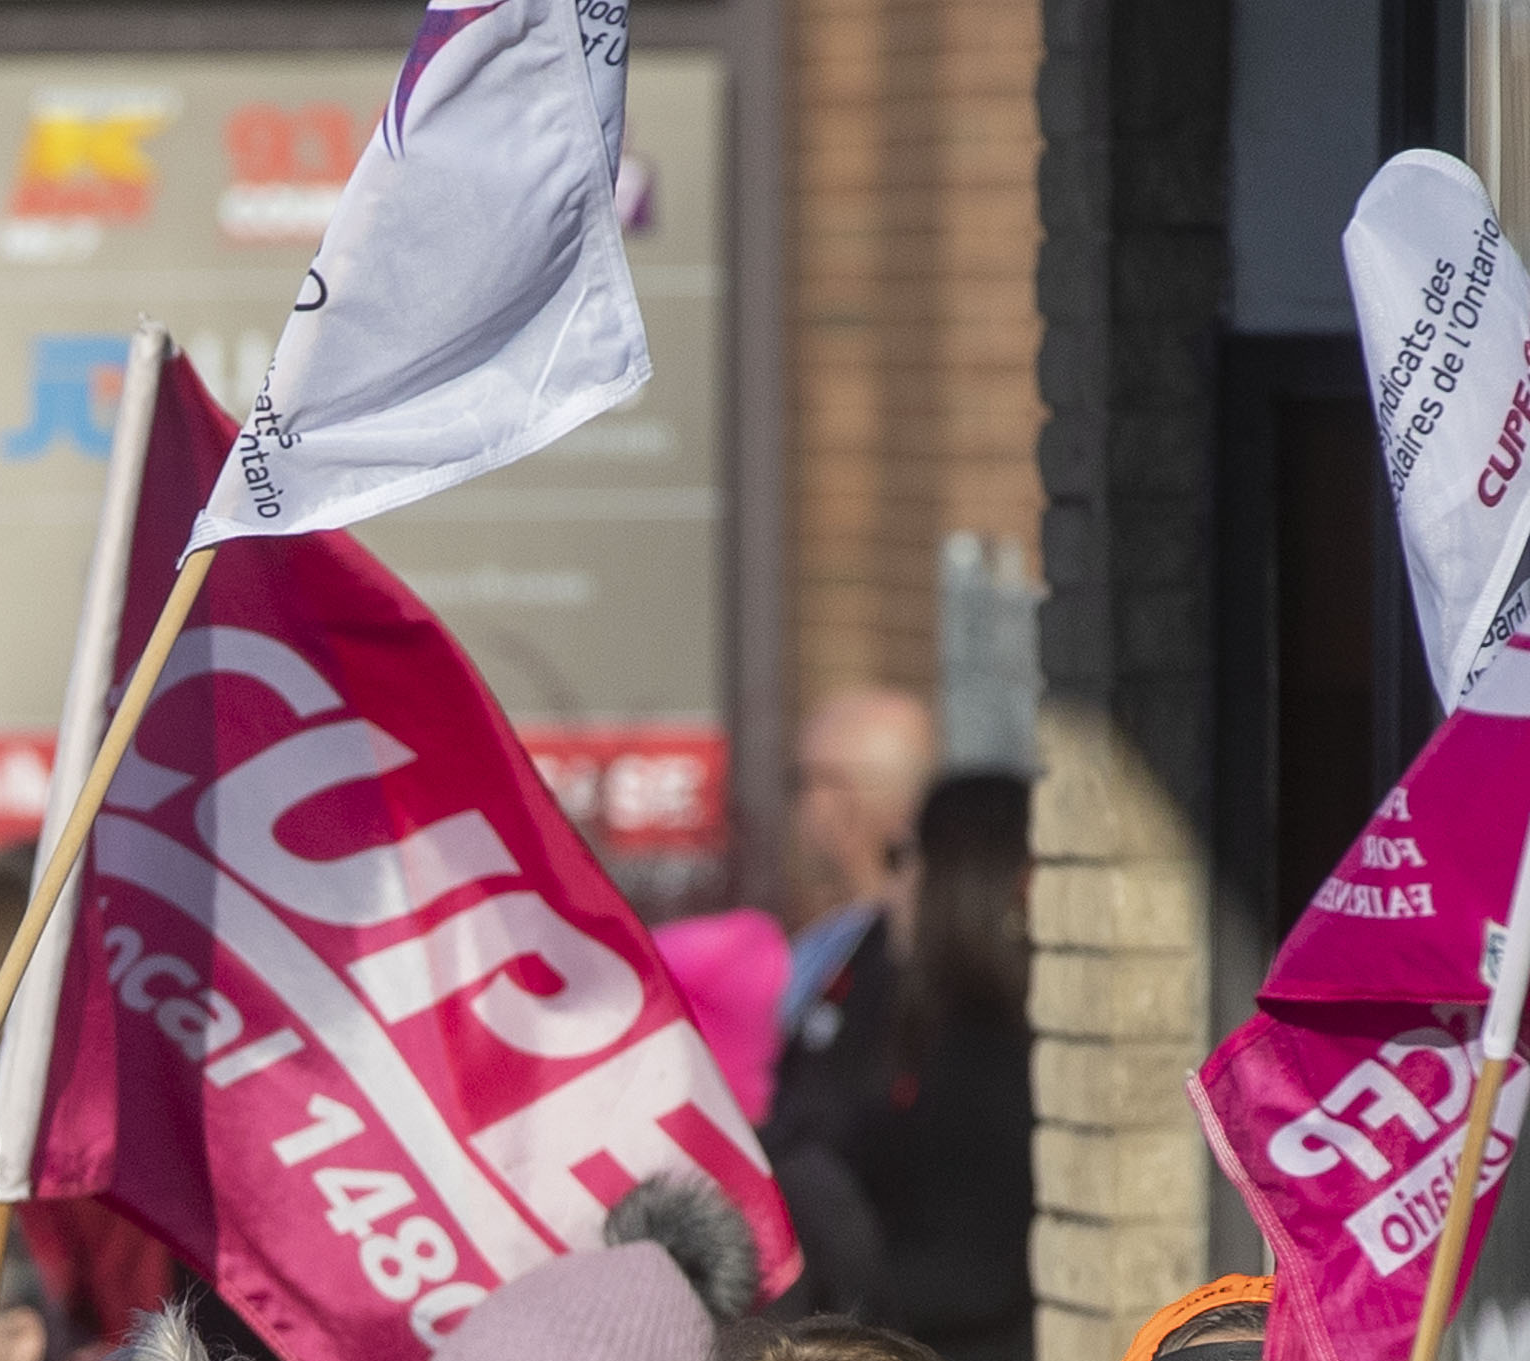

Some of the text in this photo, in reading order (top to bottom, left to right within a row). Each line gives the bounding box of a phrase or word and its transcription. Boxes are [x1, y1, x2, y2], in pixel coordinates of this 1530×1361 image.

[1421, 257, 1456, 314] des
[1434, 349, 1465, 395] de
[1456, 217, 1502, 350] l'Ontario
[239, 433, 282, 520] ntario
[98, 895, 305, 1088] ocal
[104, 625, 774, 1257] CUPE
